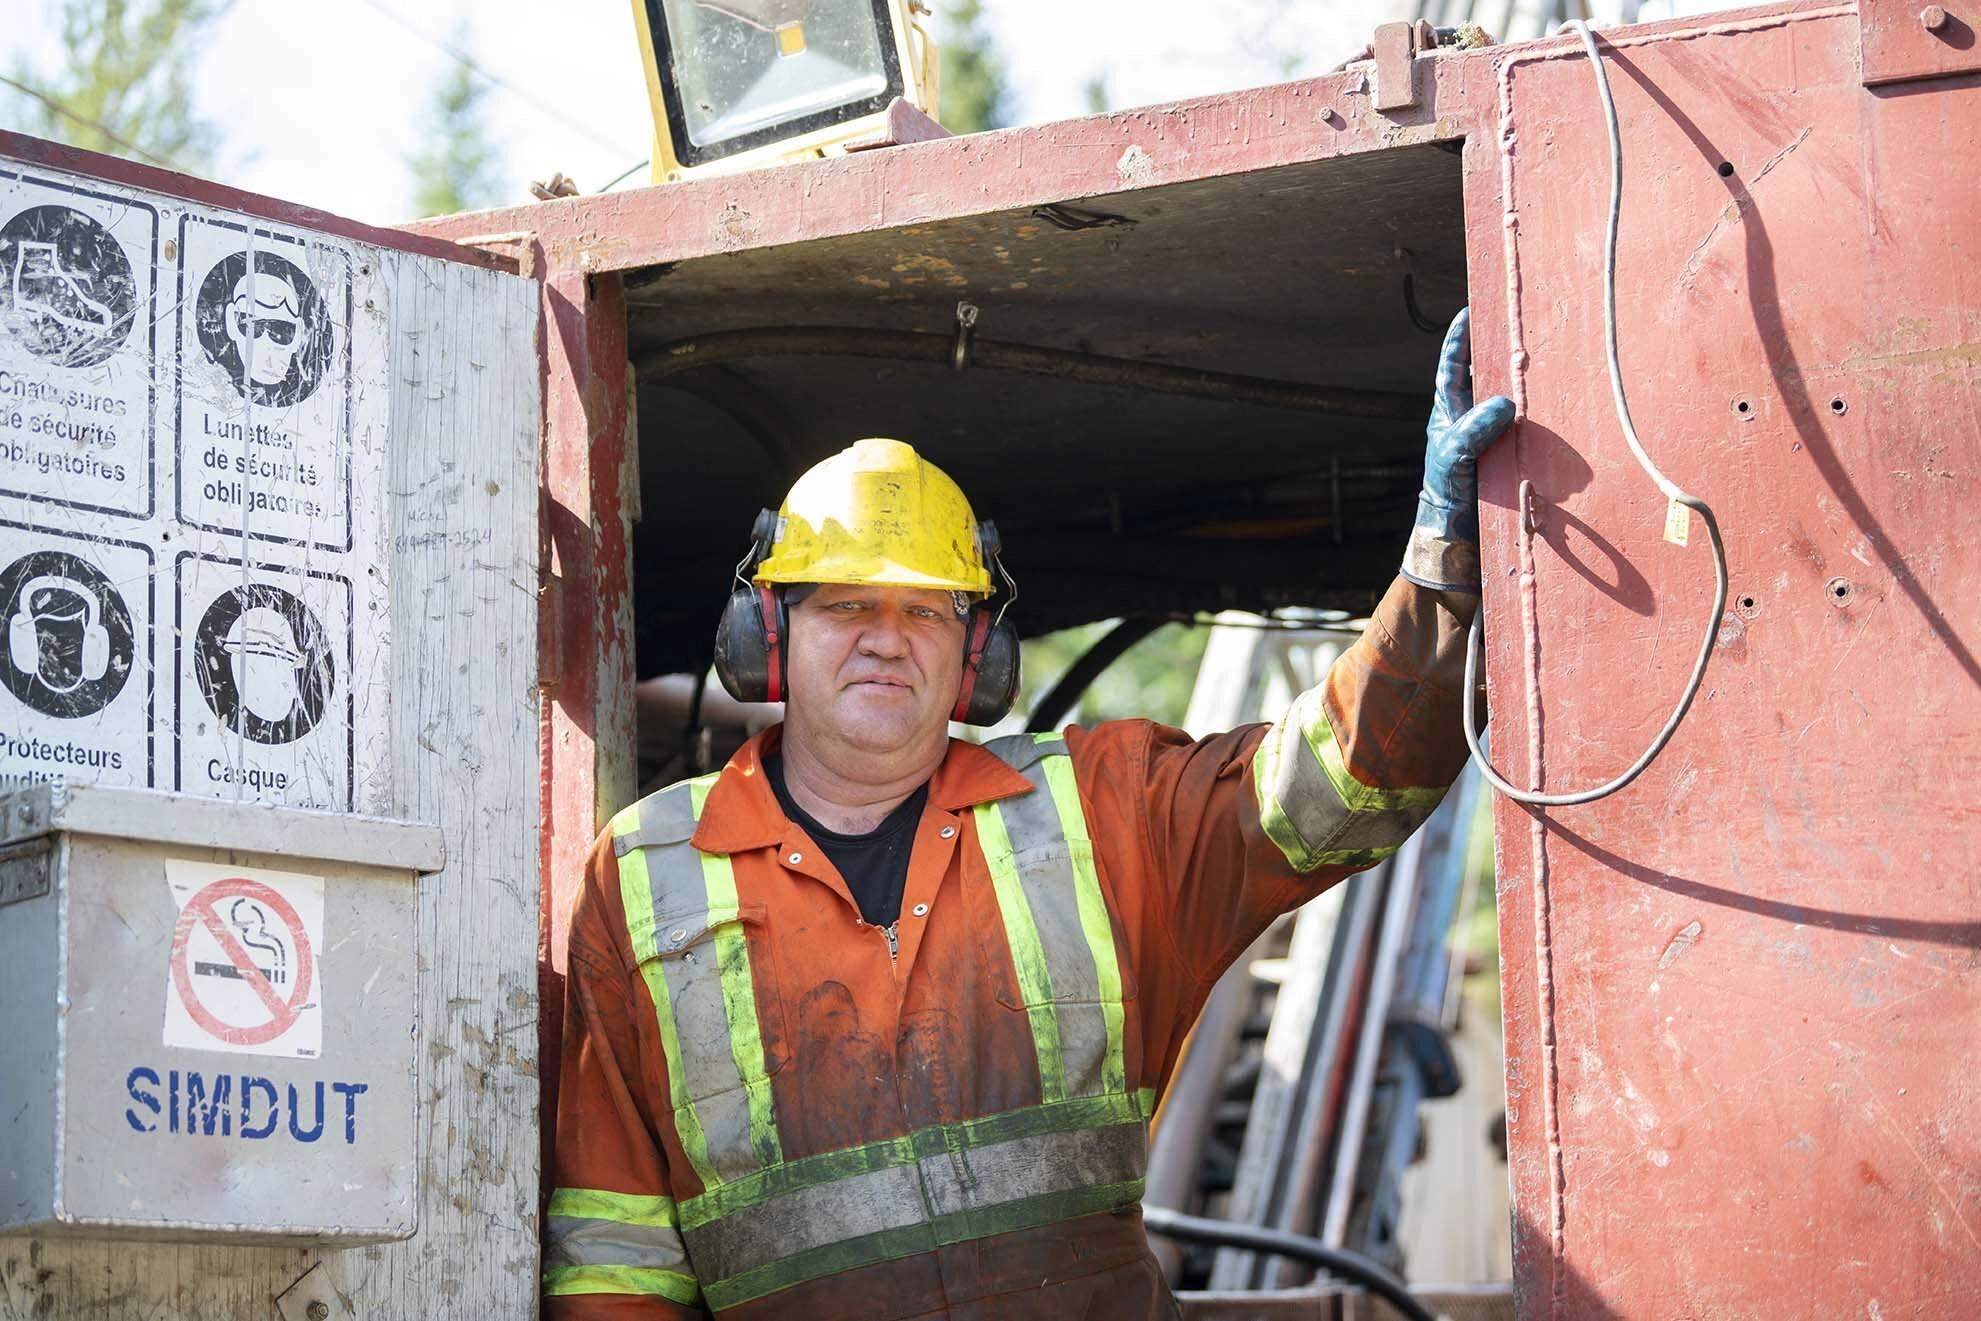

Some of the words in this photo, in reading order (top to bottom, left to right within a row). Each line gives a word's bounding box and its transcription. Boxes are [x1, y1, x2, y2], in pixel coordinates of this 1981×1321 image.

[0, 371, 127, 415] Chasures
[30, 413, 116, 446] sécurité
[203, 446, 228, 470] de
[235, 453, 317, 486] sécurté
[203, 480, 321, 518] obligatores
[207, 758, 287, 793] Casque
[126, 1066, 369, 1144] SIMDUT
